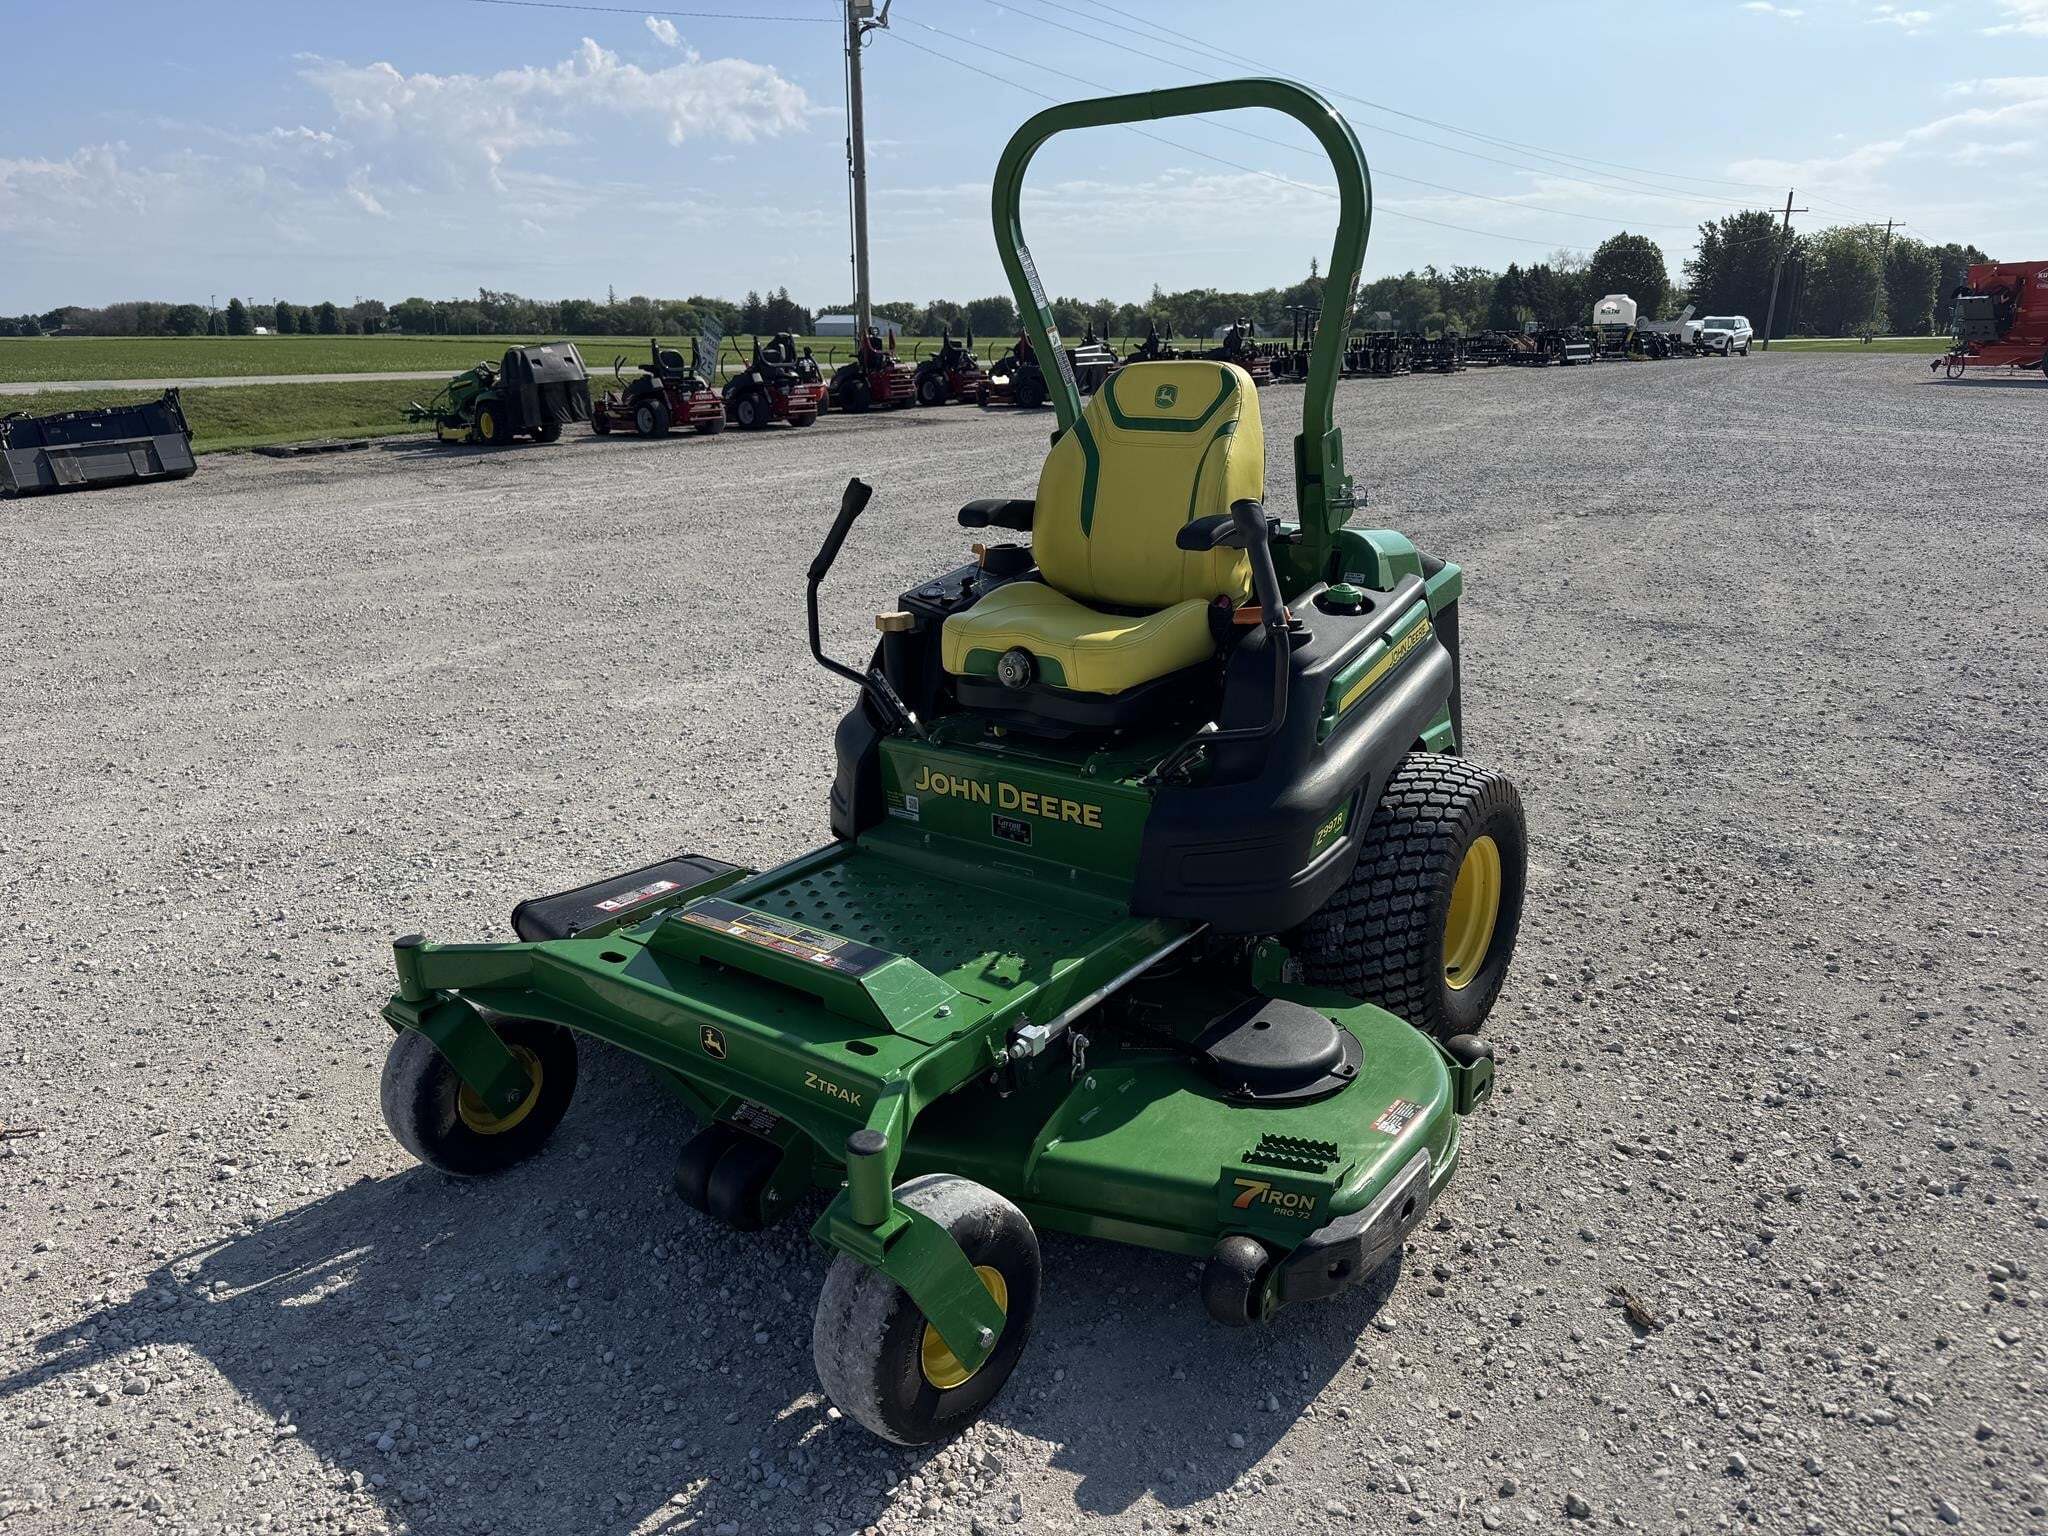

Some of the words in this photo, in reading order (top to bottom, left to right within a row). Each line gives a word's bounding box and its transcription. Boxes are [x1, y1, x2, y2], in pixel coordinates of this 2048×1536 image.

[1407, 622, 1427, 650] DEERE
[915, 766, 990, 805] JOHN
[998, 782, 1102, 829] DEERE
[804, 1071, 863, 1107] ZTRAK
[1273, 1207, 1295, 1217] PRO
